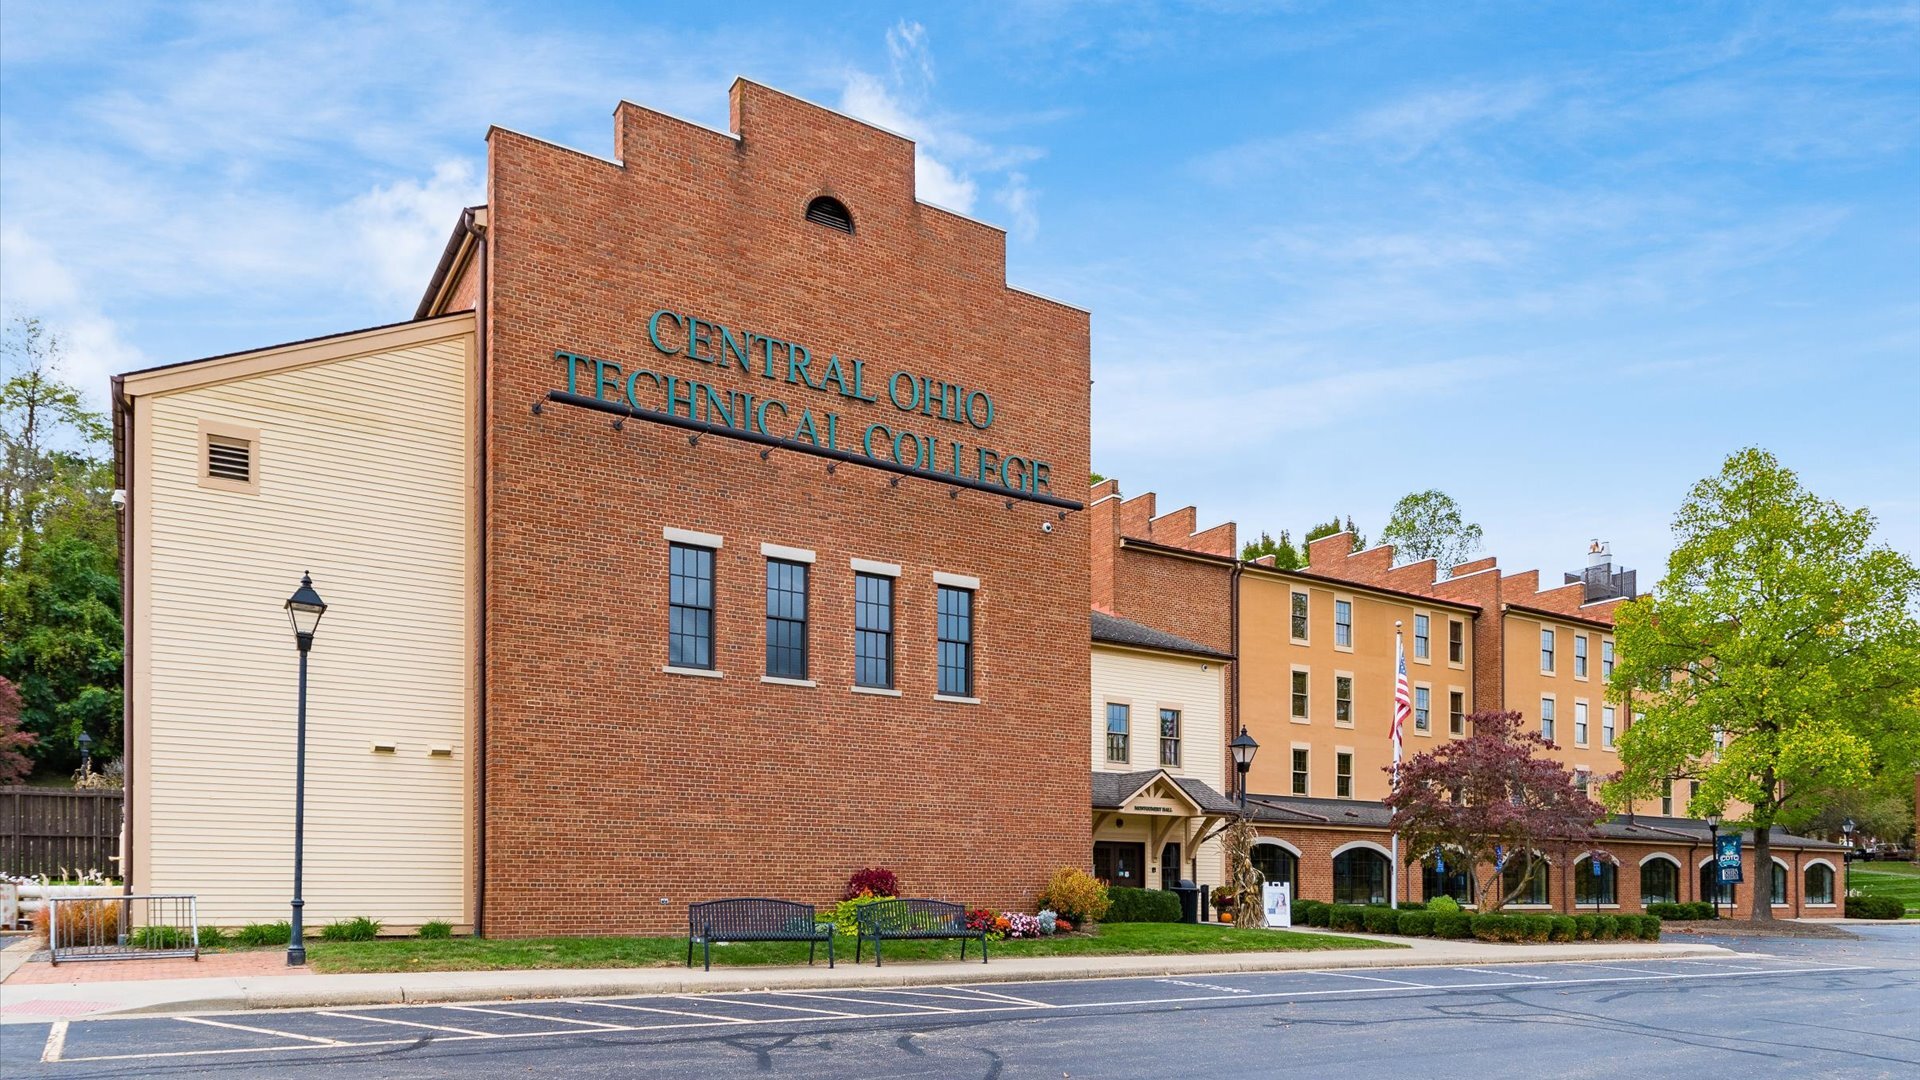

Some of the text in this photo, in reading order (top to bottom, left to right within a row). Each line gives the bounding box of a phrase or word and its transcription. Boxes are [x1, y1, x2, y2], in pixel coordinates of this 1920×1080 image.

[554, 351, 1052, 496] TECHNICAL COLLEGE
[648, 308, 994, 429] CENTRAL OHIO
